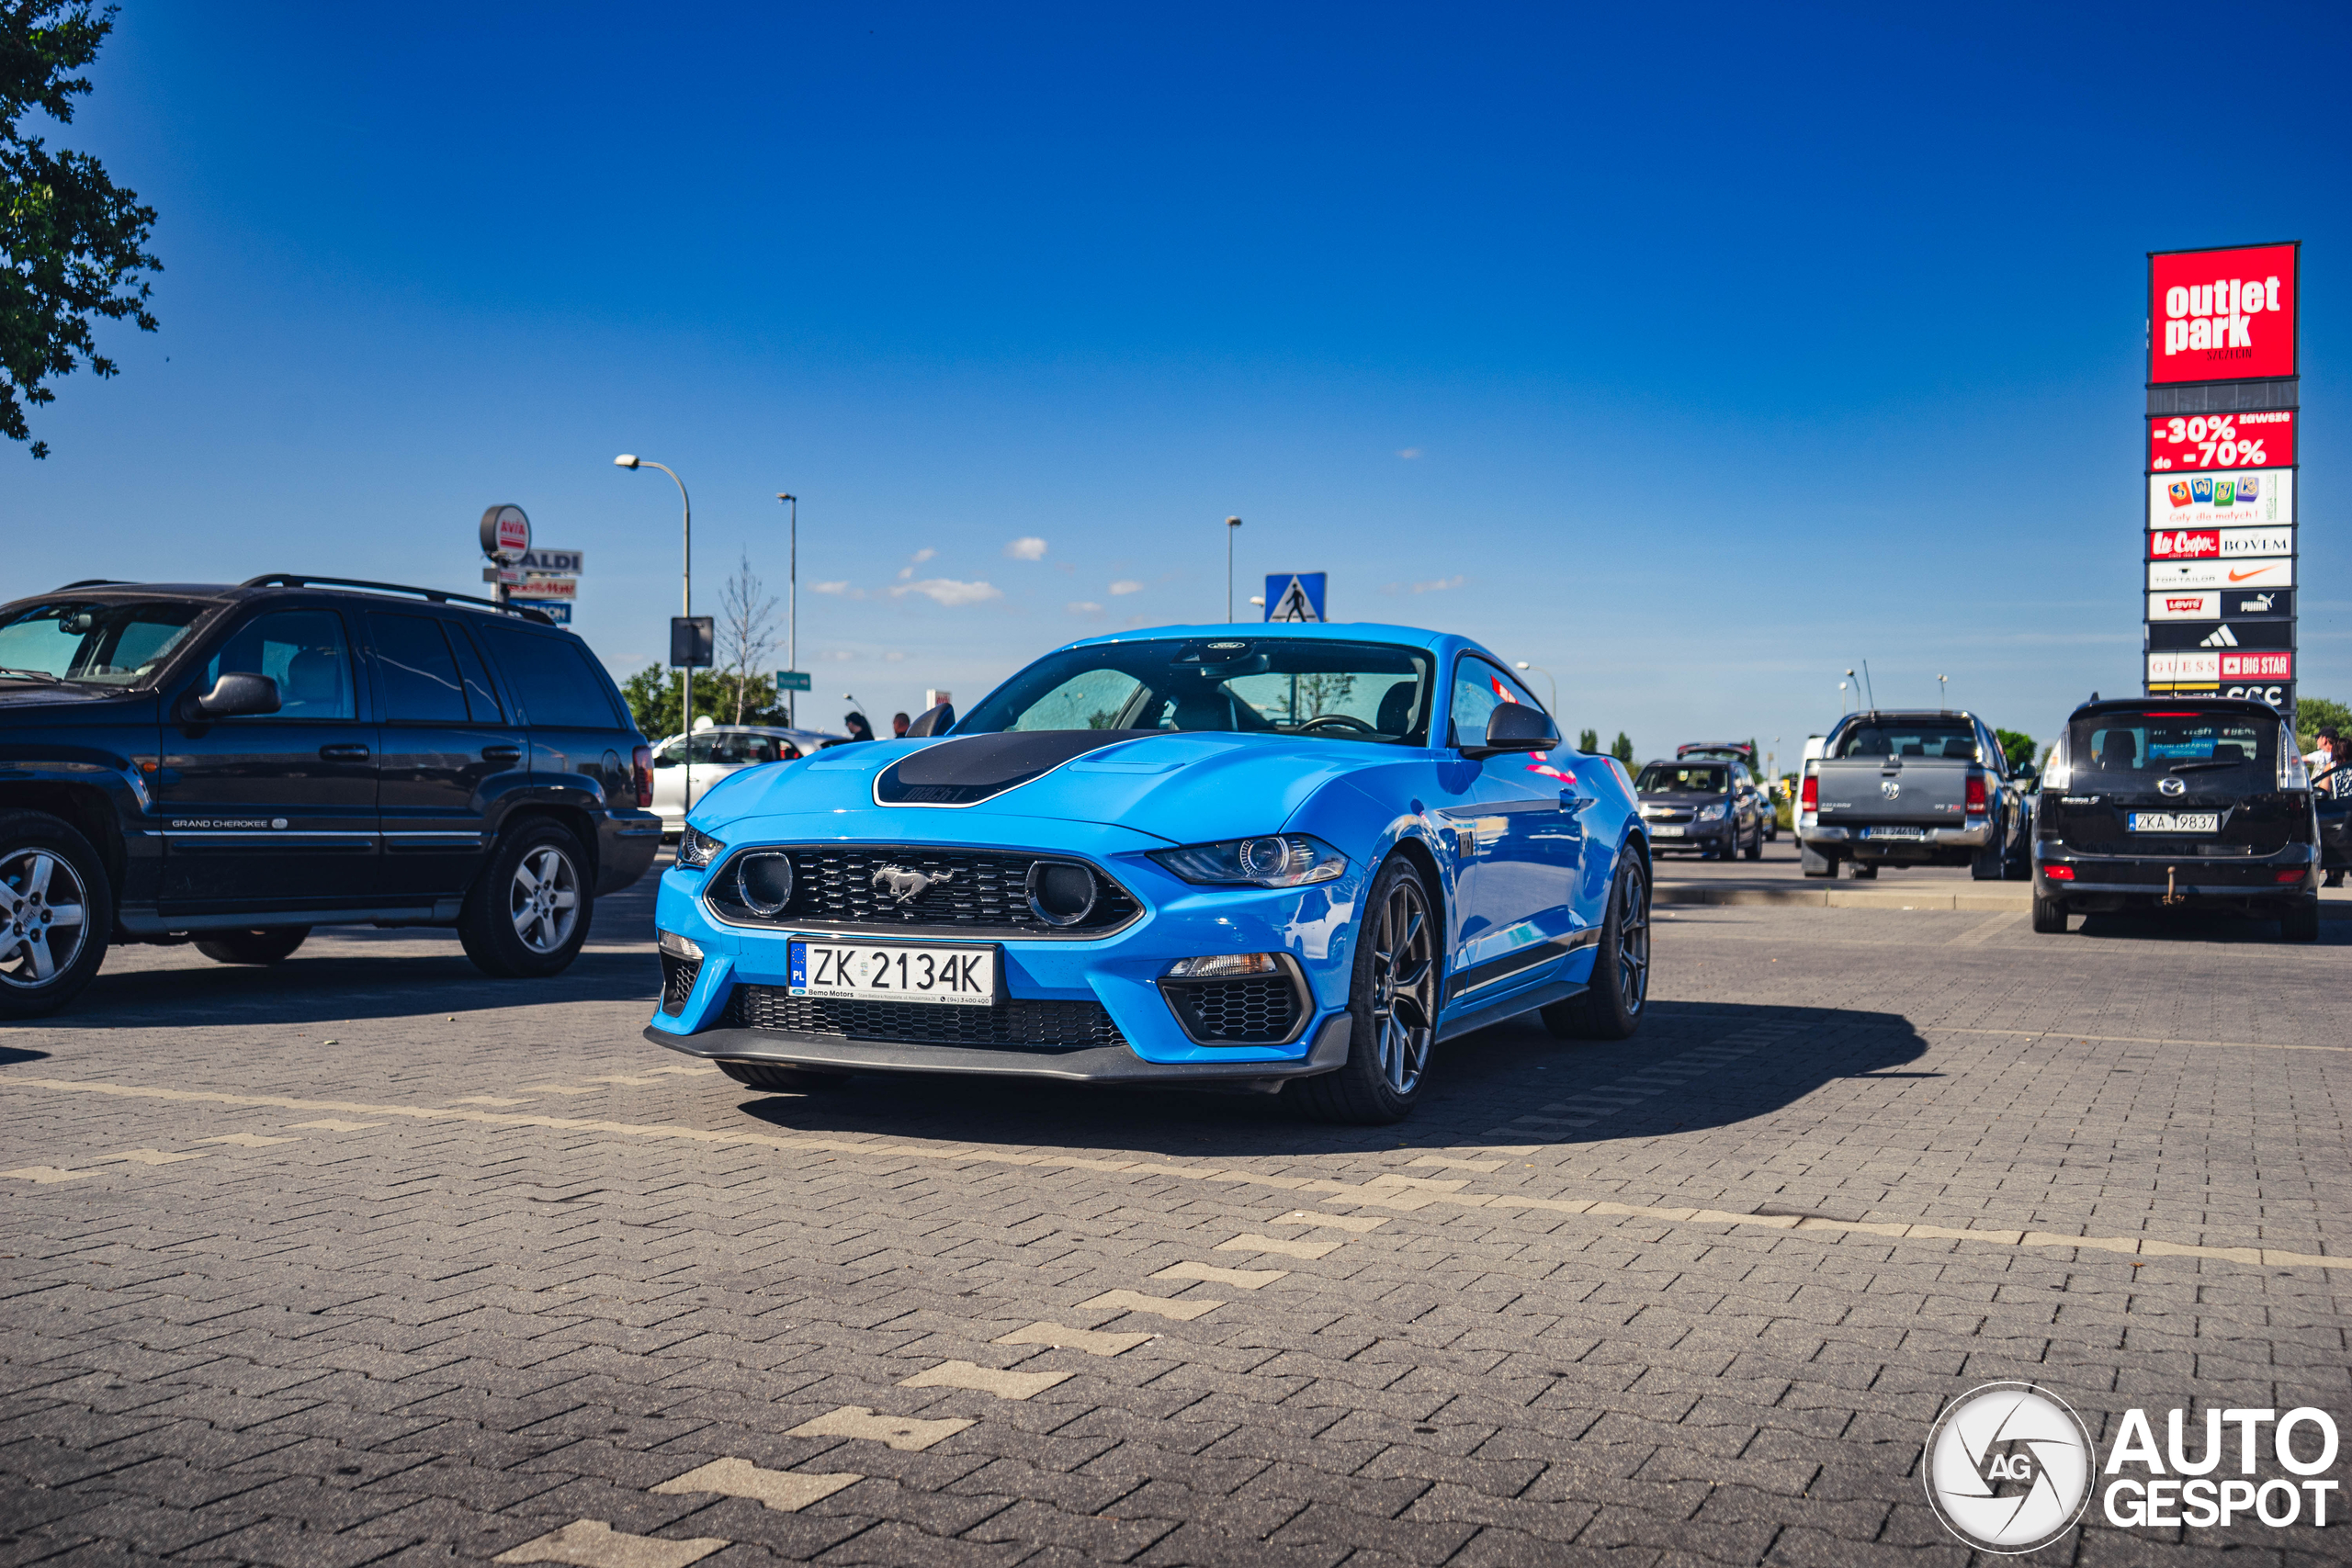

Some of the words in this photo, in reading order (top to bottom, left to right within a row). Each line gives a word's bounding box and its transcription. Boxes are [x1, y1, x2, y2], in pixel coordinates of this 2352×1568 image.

[2165, 276, 2280, 318] outlet
[2165, 313, 2252, 355] park
[2154, 415, 2236, 444] -30%
[2154, 456, 2172, 469] do
[2183, 439, 2267, 468] -70%
[519, 553, 579, 570] ALDI
[2153, 660, 2216, 673] GUESS
[2242, 658, 2259, 674] BIG
[2261, 657, 2287, 674] STAR
[172, 819, 210, 828] GRAND
[2137, 814, 2165, 829] ZKA
[793, 970, 805, 981] PL
[813, 948, 856, 987] ZK
[871, 951, 983, 993] 2134K
